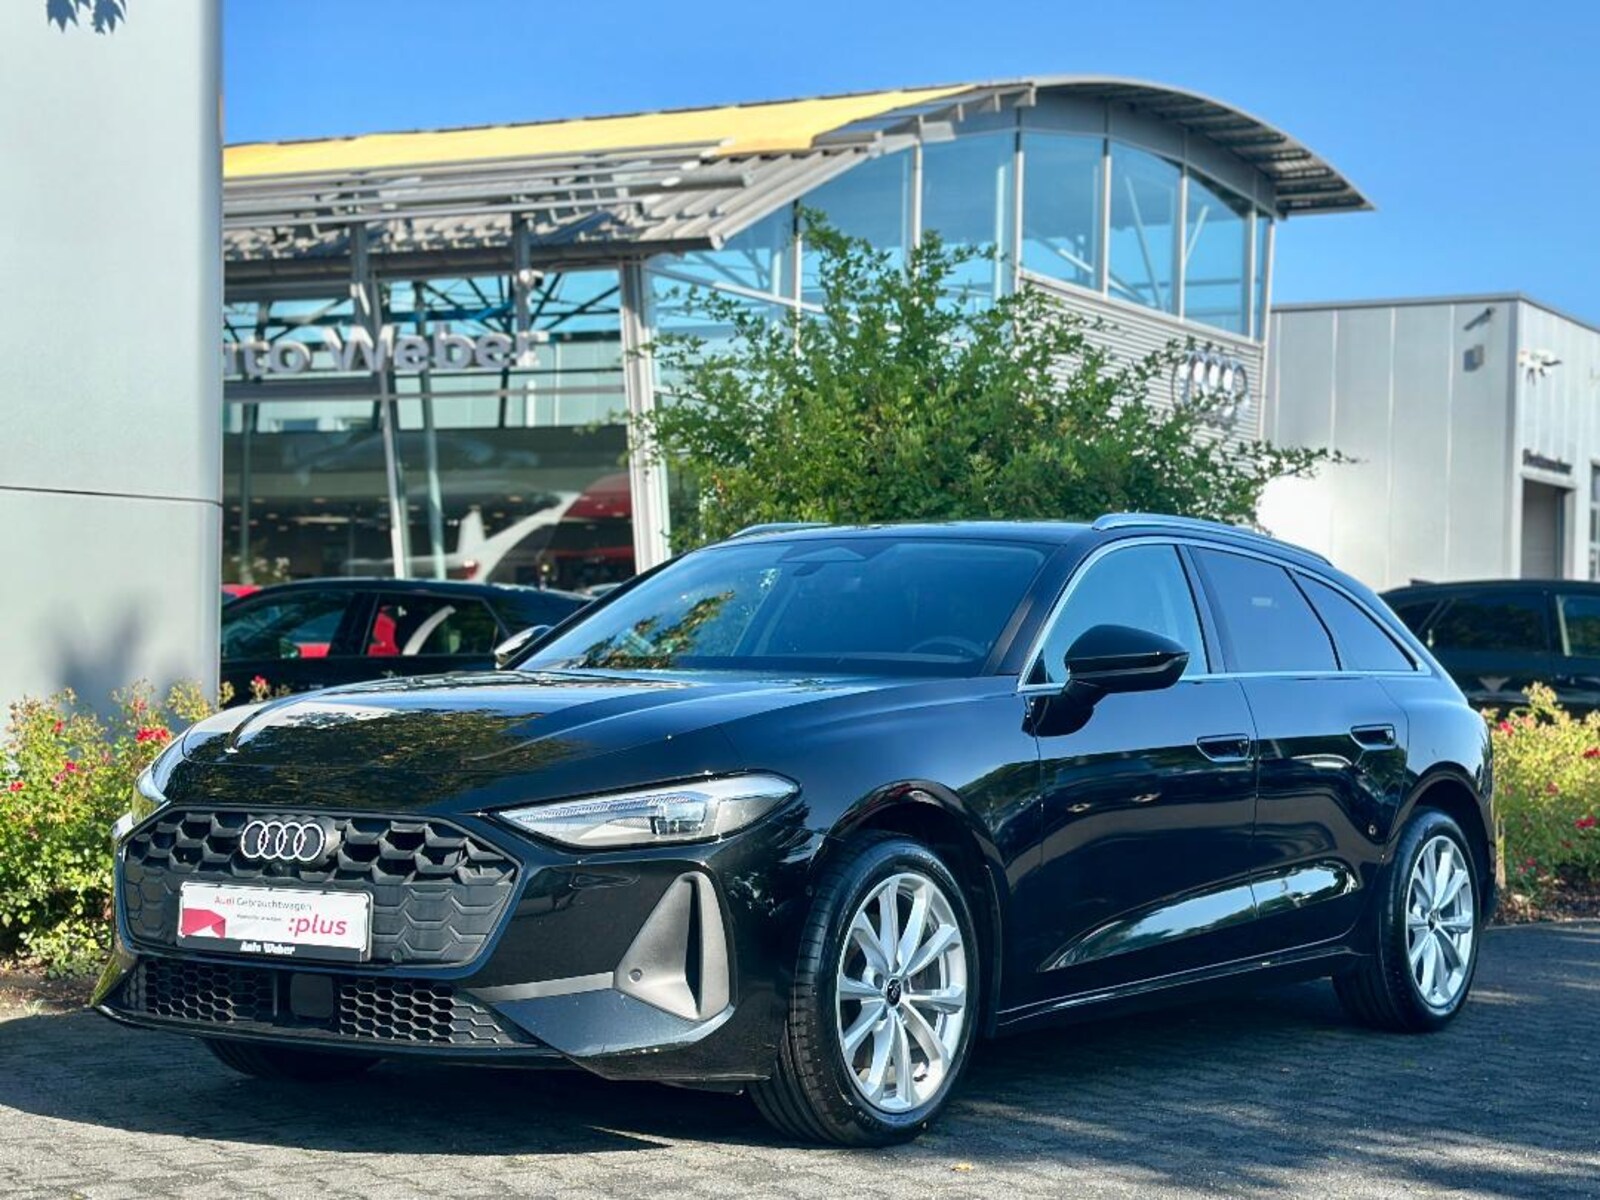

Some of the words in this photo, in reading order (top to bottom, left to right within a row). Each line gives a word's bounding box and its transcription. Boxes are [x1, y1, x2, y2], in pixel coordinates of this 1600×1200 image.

[323, 324, 548, 371] Weber
[214, 896, 235, 906] Audi
[237, 897, 312, 912] Gebrauchtwagen
[288, 914, 347, 938] :plus
[263, 942, 295, 955] Weber
